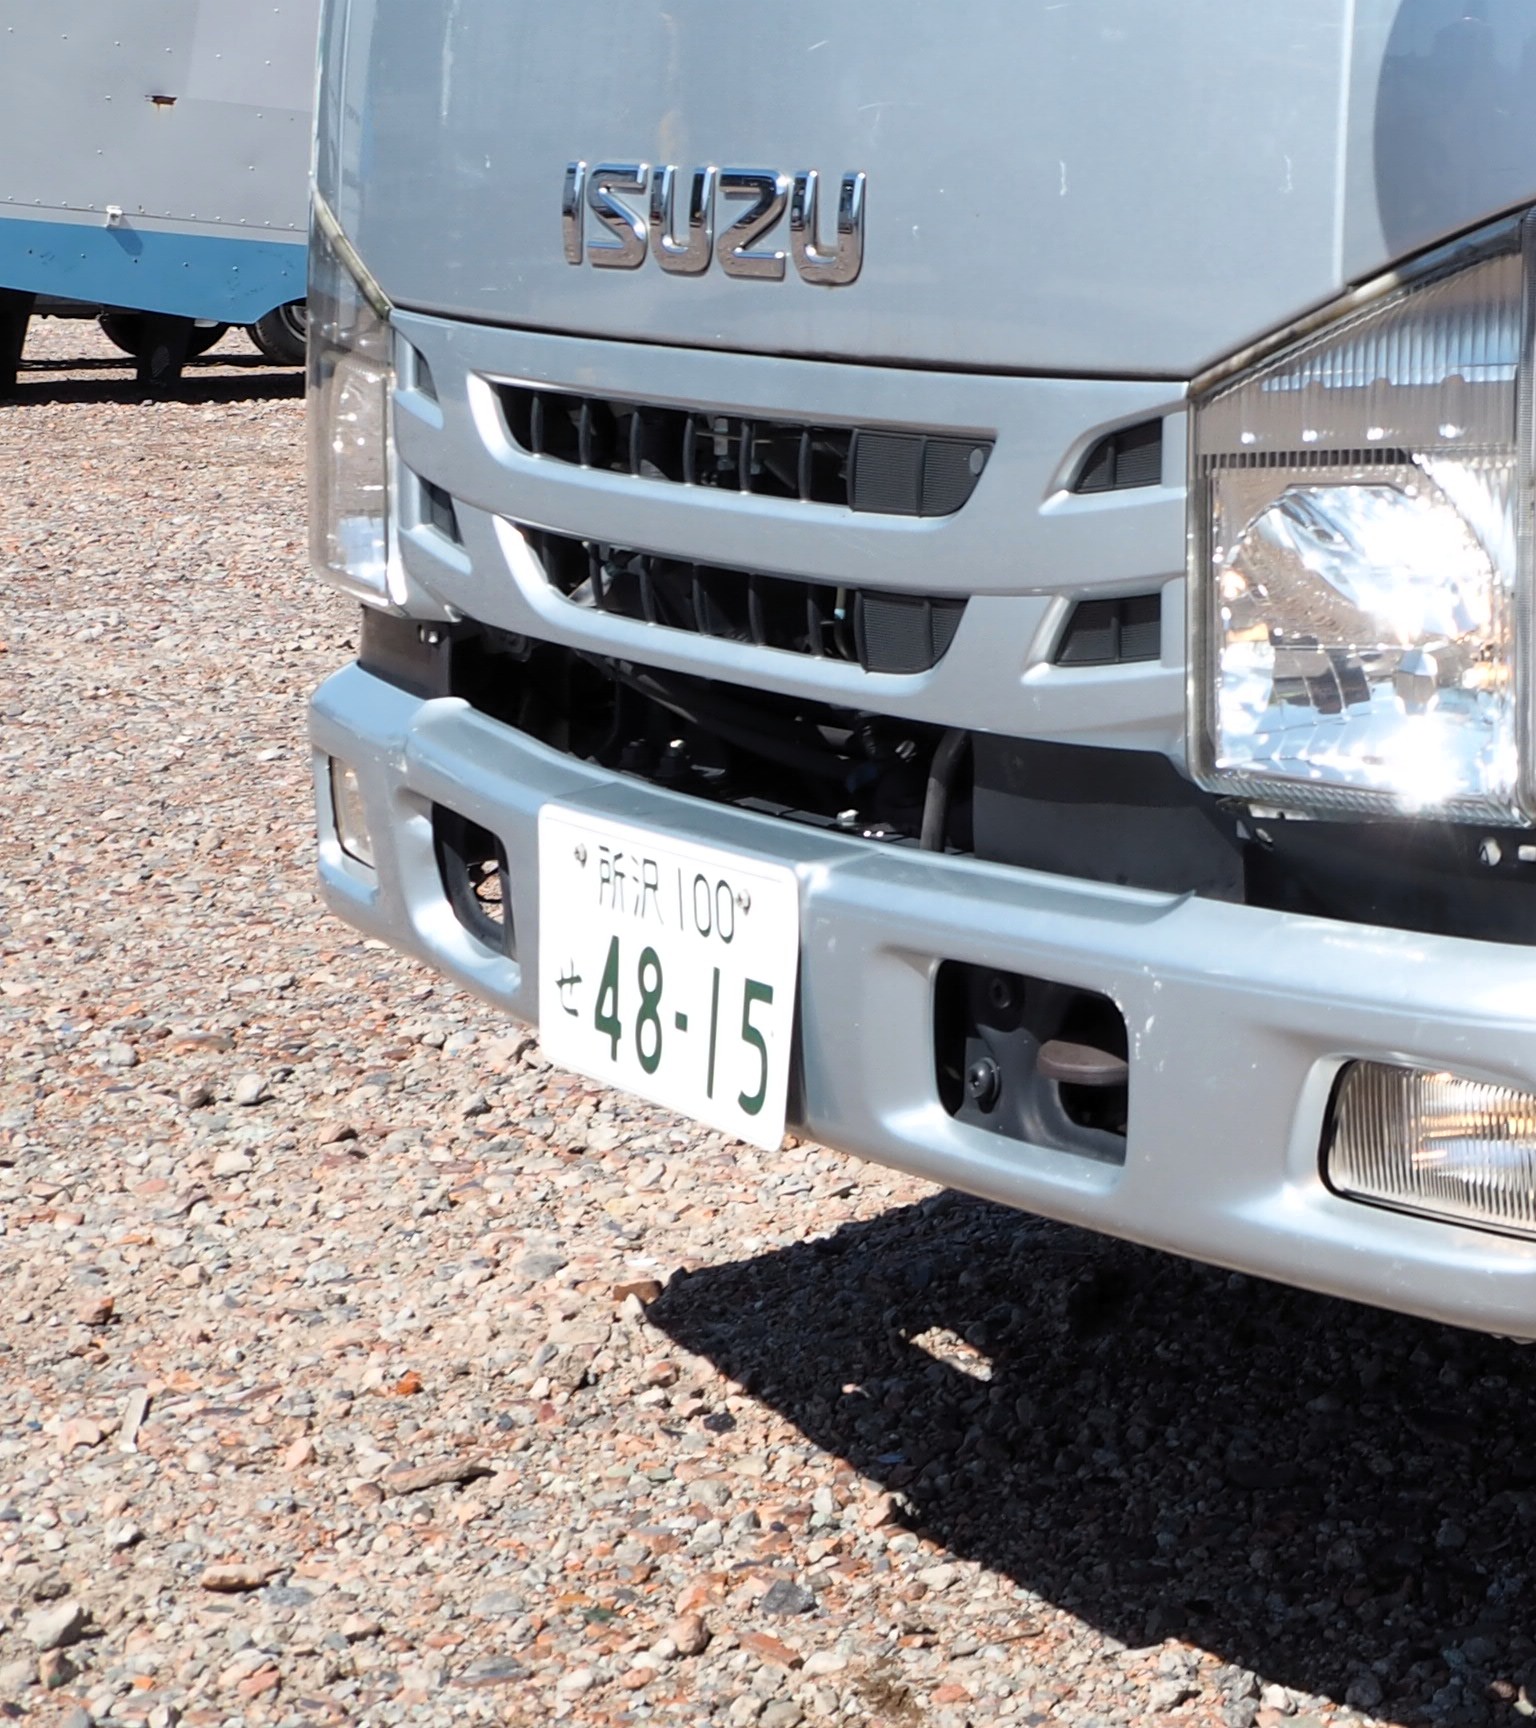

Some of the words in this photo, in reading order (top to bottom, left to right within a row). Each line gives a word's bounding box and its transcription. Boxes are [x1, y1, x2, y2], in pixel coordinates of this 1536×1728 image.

[561, 160, 868, 287] ISUZU
[599, 845, 664, 925] 所沢
[677, 867, 735, 944] 100
[555, 957, 583, 1018] せ
[594, 934, 774, 1116] 48-15
